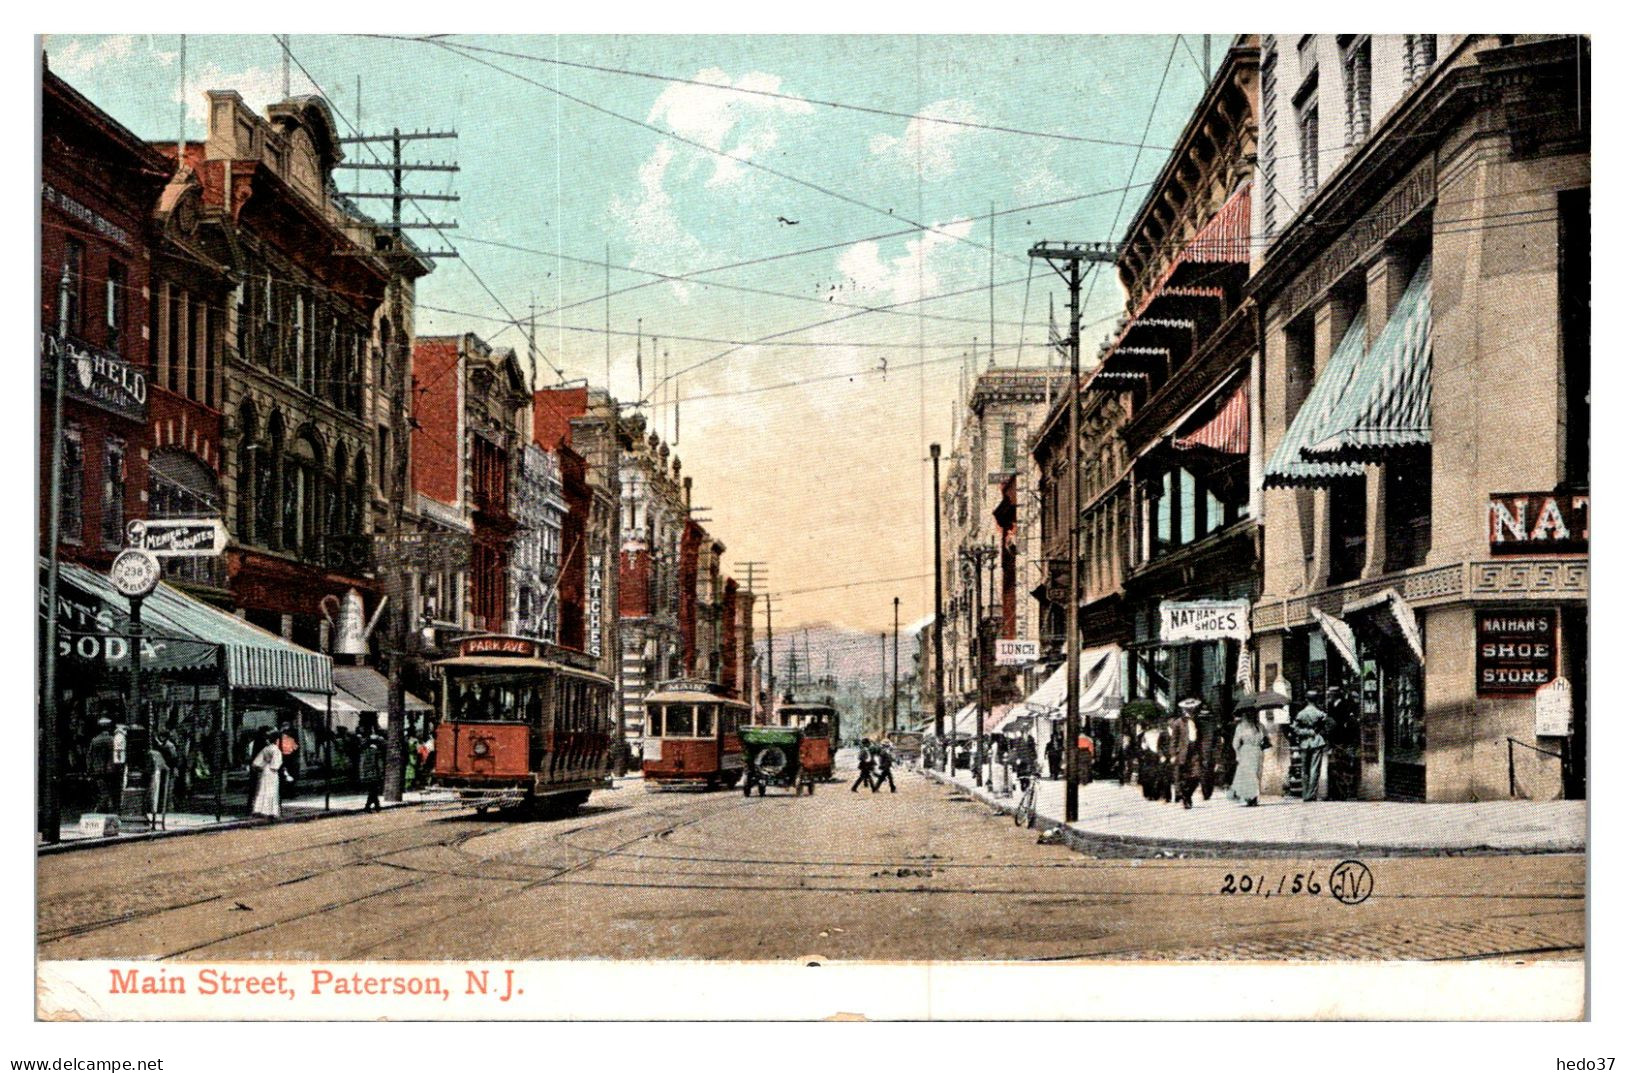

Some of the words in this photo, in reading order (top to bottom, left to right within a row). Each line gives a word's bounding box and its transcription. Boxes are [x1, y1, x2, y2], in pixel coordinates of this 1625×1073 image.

[93, 355, 146, 404] HELD
[590, 555, 601, 658] WATCHES
[1171, 610, 1217, 629] NATHAN
[469, 640, 500, 652] PARK
[1001, 643, 1035, 655] LUNCH
[1482, 643, 1550, 657] SHOE
[1483, 668, 1549, 683] STORE
